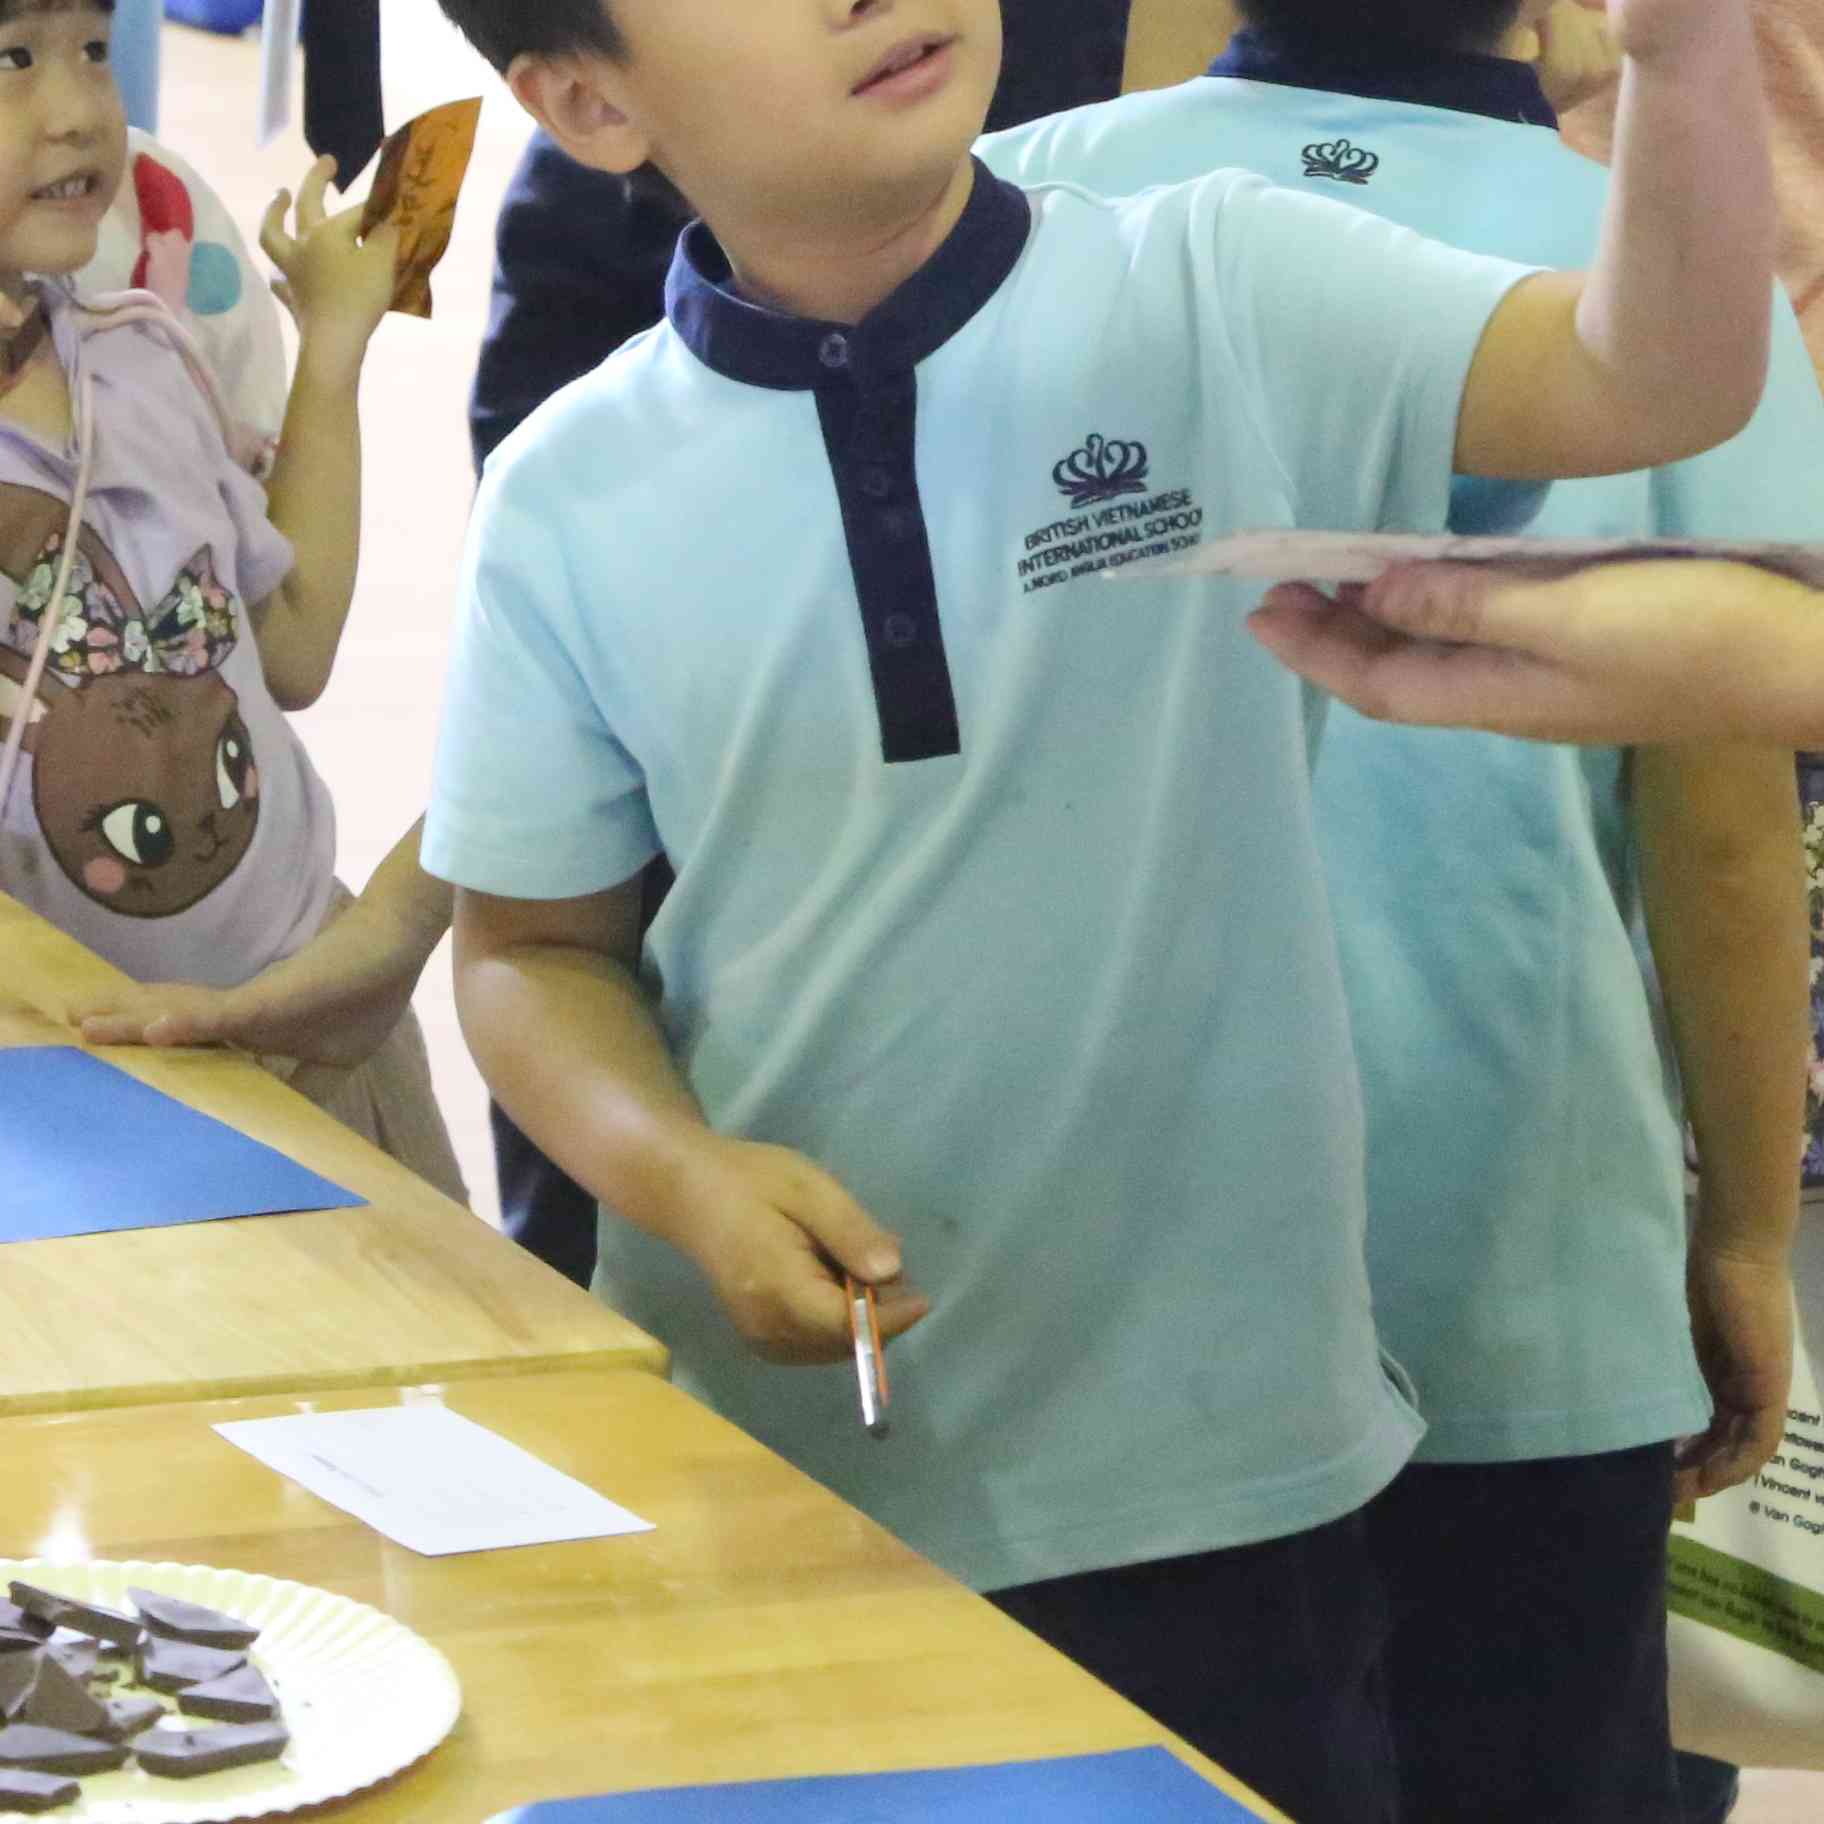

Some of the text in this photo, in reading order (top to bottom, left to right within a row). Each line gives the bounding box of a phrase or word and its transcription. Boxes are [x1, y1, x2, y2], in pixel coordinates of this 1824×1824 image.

[1024, 487, 1193, 551] BRITISH VIETNAMESE
[1016, 527, 1143, 577] INTERNATIONAL
[1763, 1504, 1790, 1522] Van
